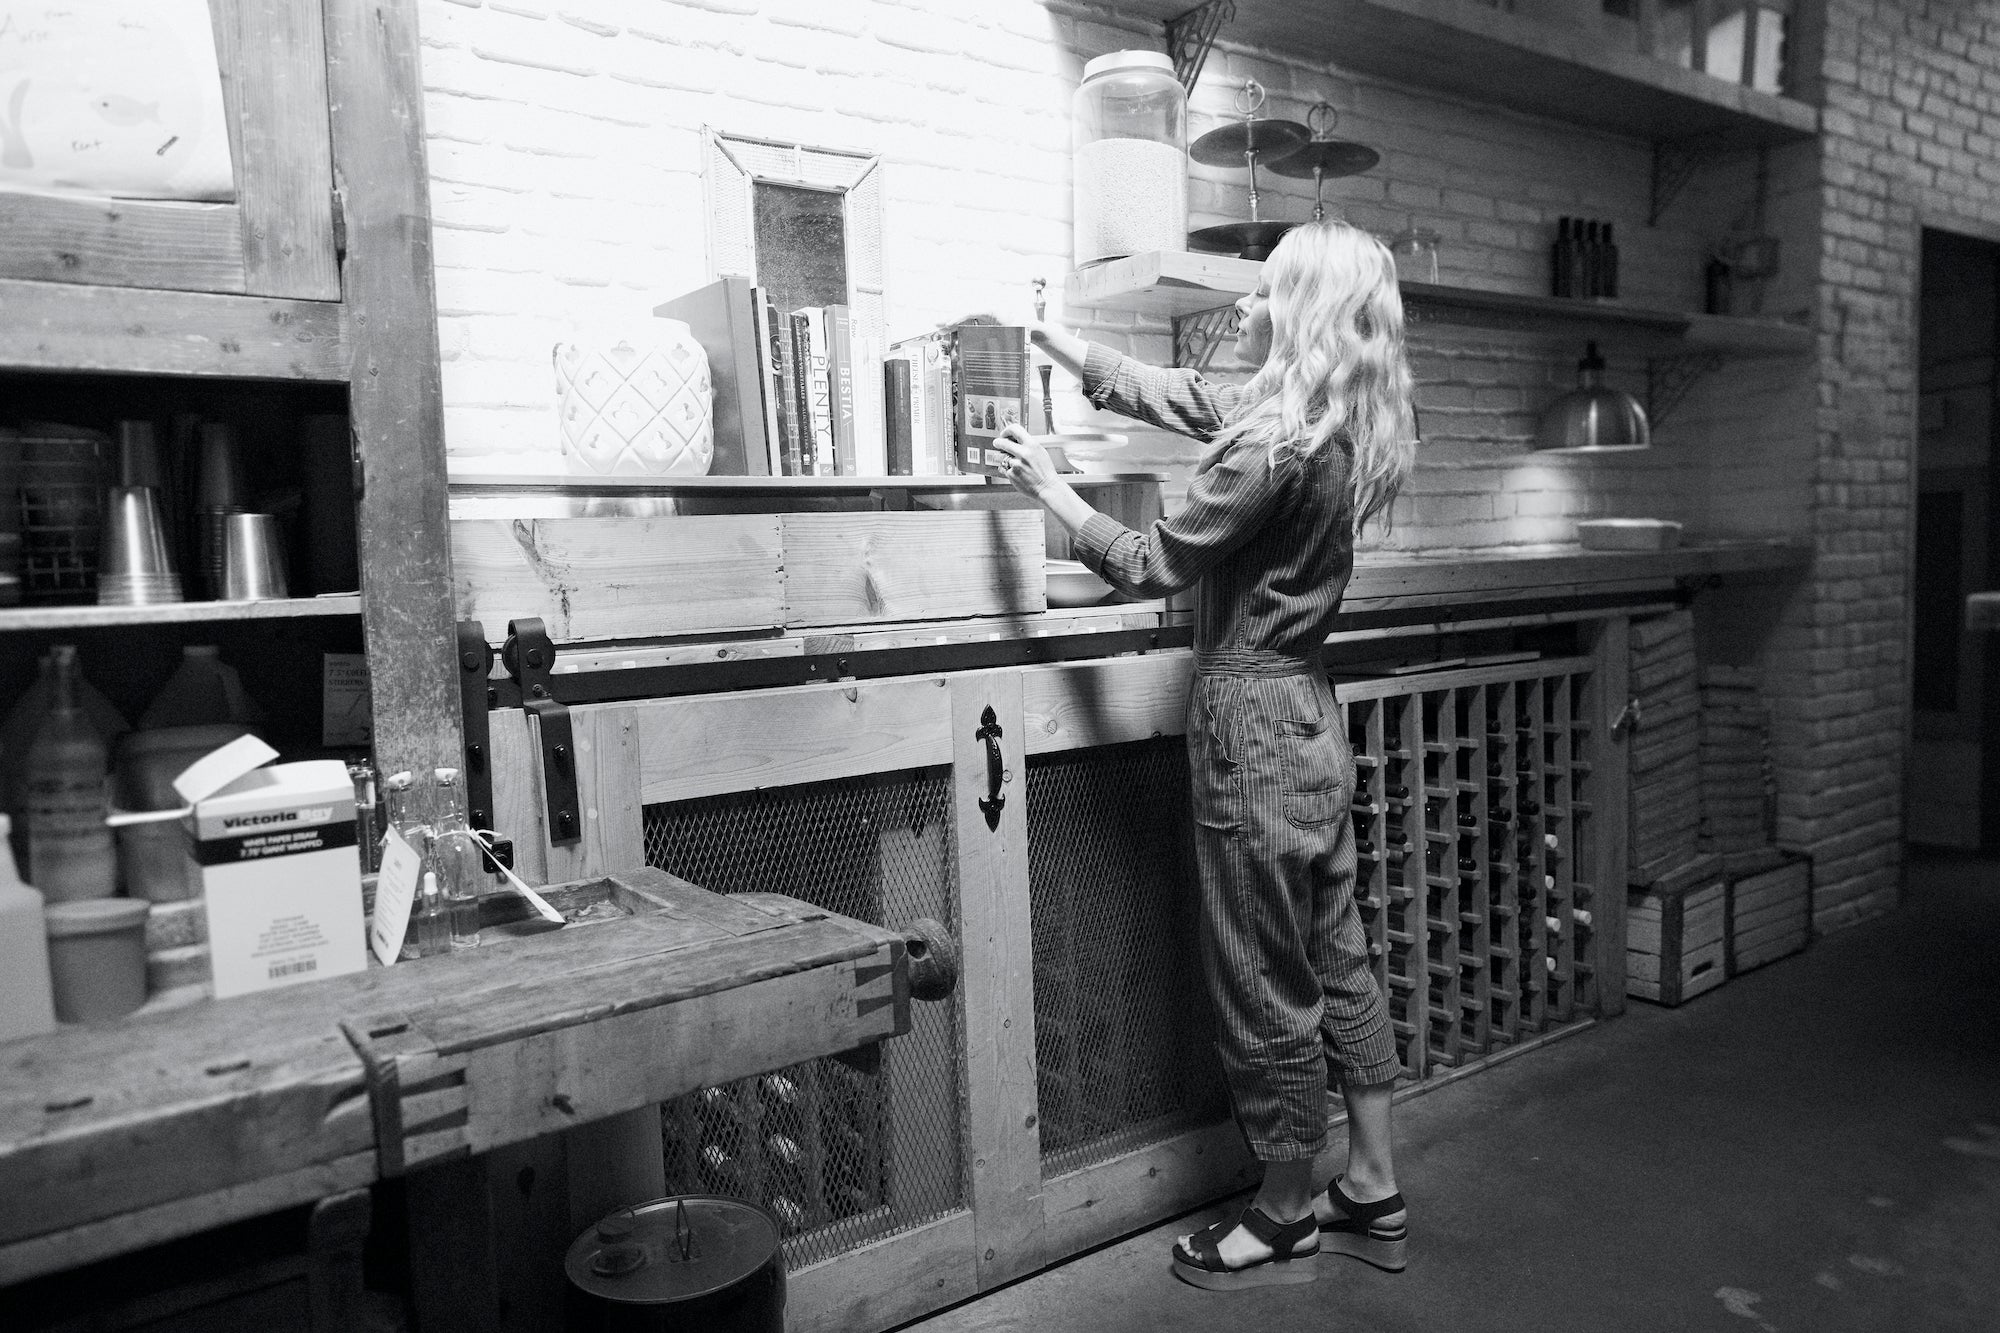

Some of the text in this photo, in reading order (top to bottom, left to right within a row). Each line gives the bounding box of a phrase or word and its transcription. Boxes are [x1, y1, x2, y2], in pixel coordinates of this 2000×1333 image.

[798, 362, 806, 400] VEGETABLES
[812, 355, 831, 437] PLENTY
[839, 367, 853, 420] BESTIA
[911, 354, 920, 425] CHEESE PRIMER
[223, 811, 297, 829] Victoria
[268, 833, 292, 845] PAPER
[286, 839, 324, 852] WRAPPED
